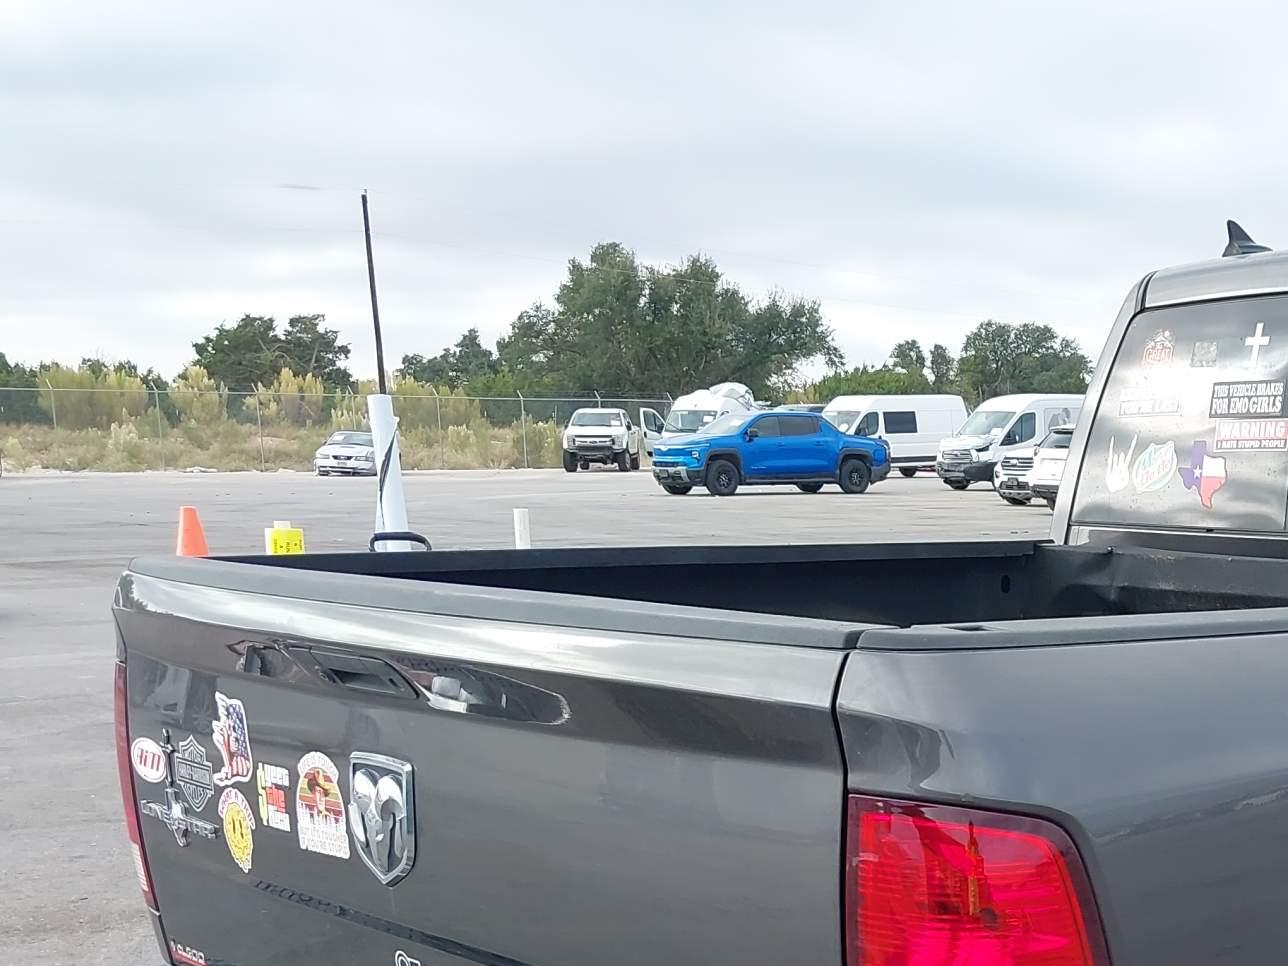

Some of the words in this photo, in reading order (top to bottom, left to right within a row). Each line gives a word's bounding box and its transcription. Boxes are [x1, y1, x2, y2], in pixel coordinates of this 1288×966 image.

[1214, 385, 1229, 398] THIS
[1229, 384, 1257, 397] VEHICLE
[1257, 382, 1284, 396] BRAKES
[1211, 398, 1229, 414] FOR
[1229, 397, 1249, 413] EMO
[1249, 396, 1282, 413] GIRLS
[1220, 421, 1286, 440] WARNING
[1222, 440, 1237, 449] HATE
[1238, 440, 1260, 449] STUPID
[1261, 440, 1285, 448] PEOPLE
